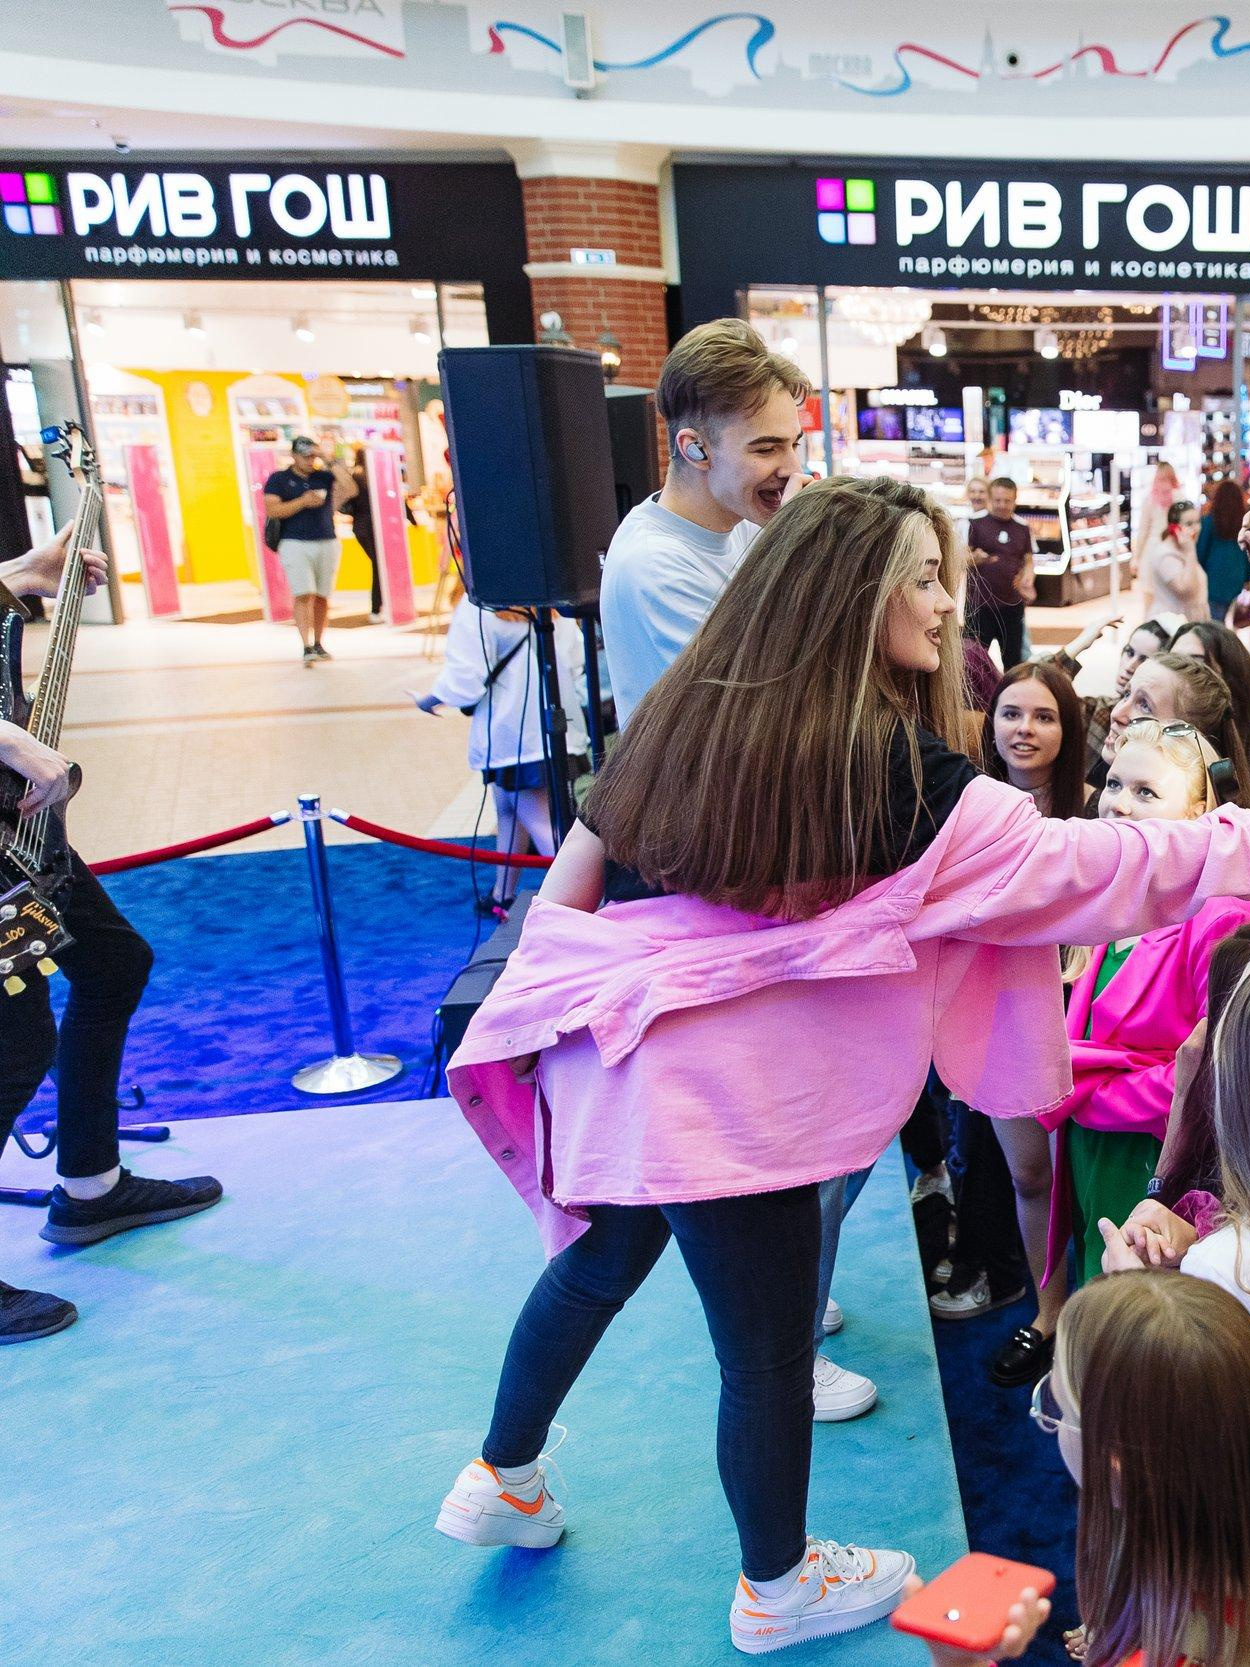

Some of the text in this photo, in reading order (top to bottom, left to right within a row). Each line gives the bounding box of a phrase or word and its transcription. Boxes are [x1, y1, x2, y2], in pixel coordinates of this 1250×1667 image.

[67, 172, 391, 239] РИВ ГОШ
[895, 179, 1062, 249] РИВ
[85, 245, 400, 267] парфюмерия и косметика
[899, 254, 1074, 278] парфюмерия
[1085, 259, 1100, 276] и
[1059, 389, 1103, 411] Dior
[20, 901, 59, 935] Gibson
[754, 1627, 775, 1636] AIR
